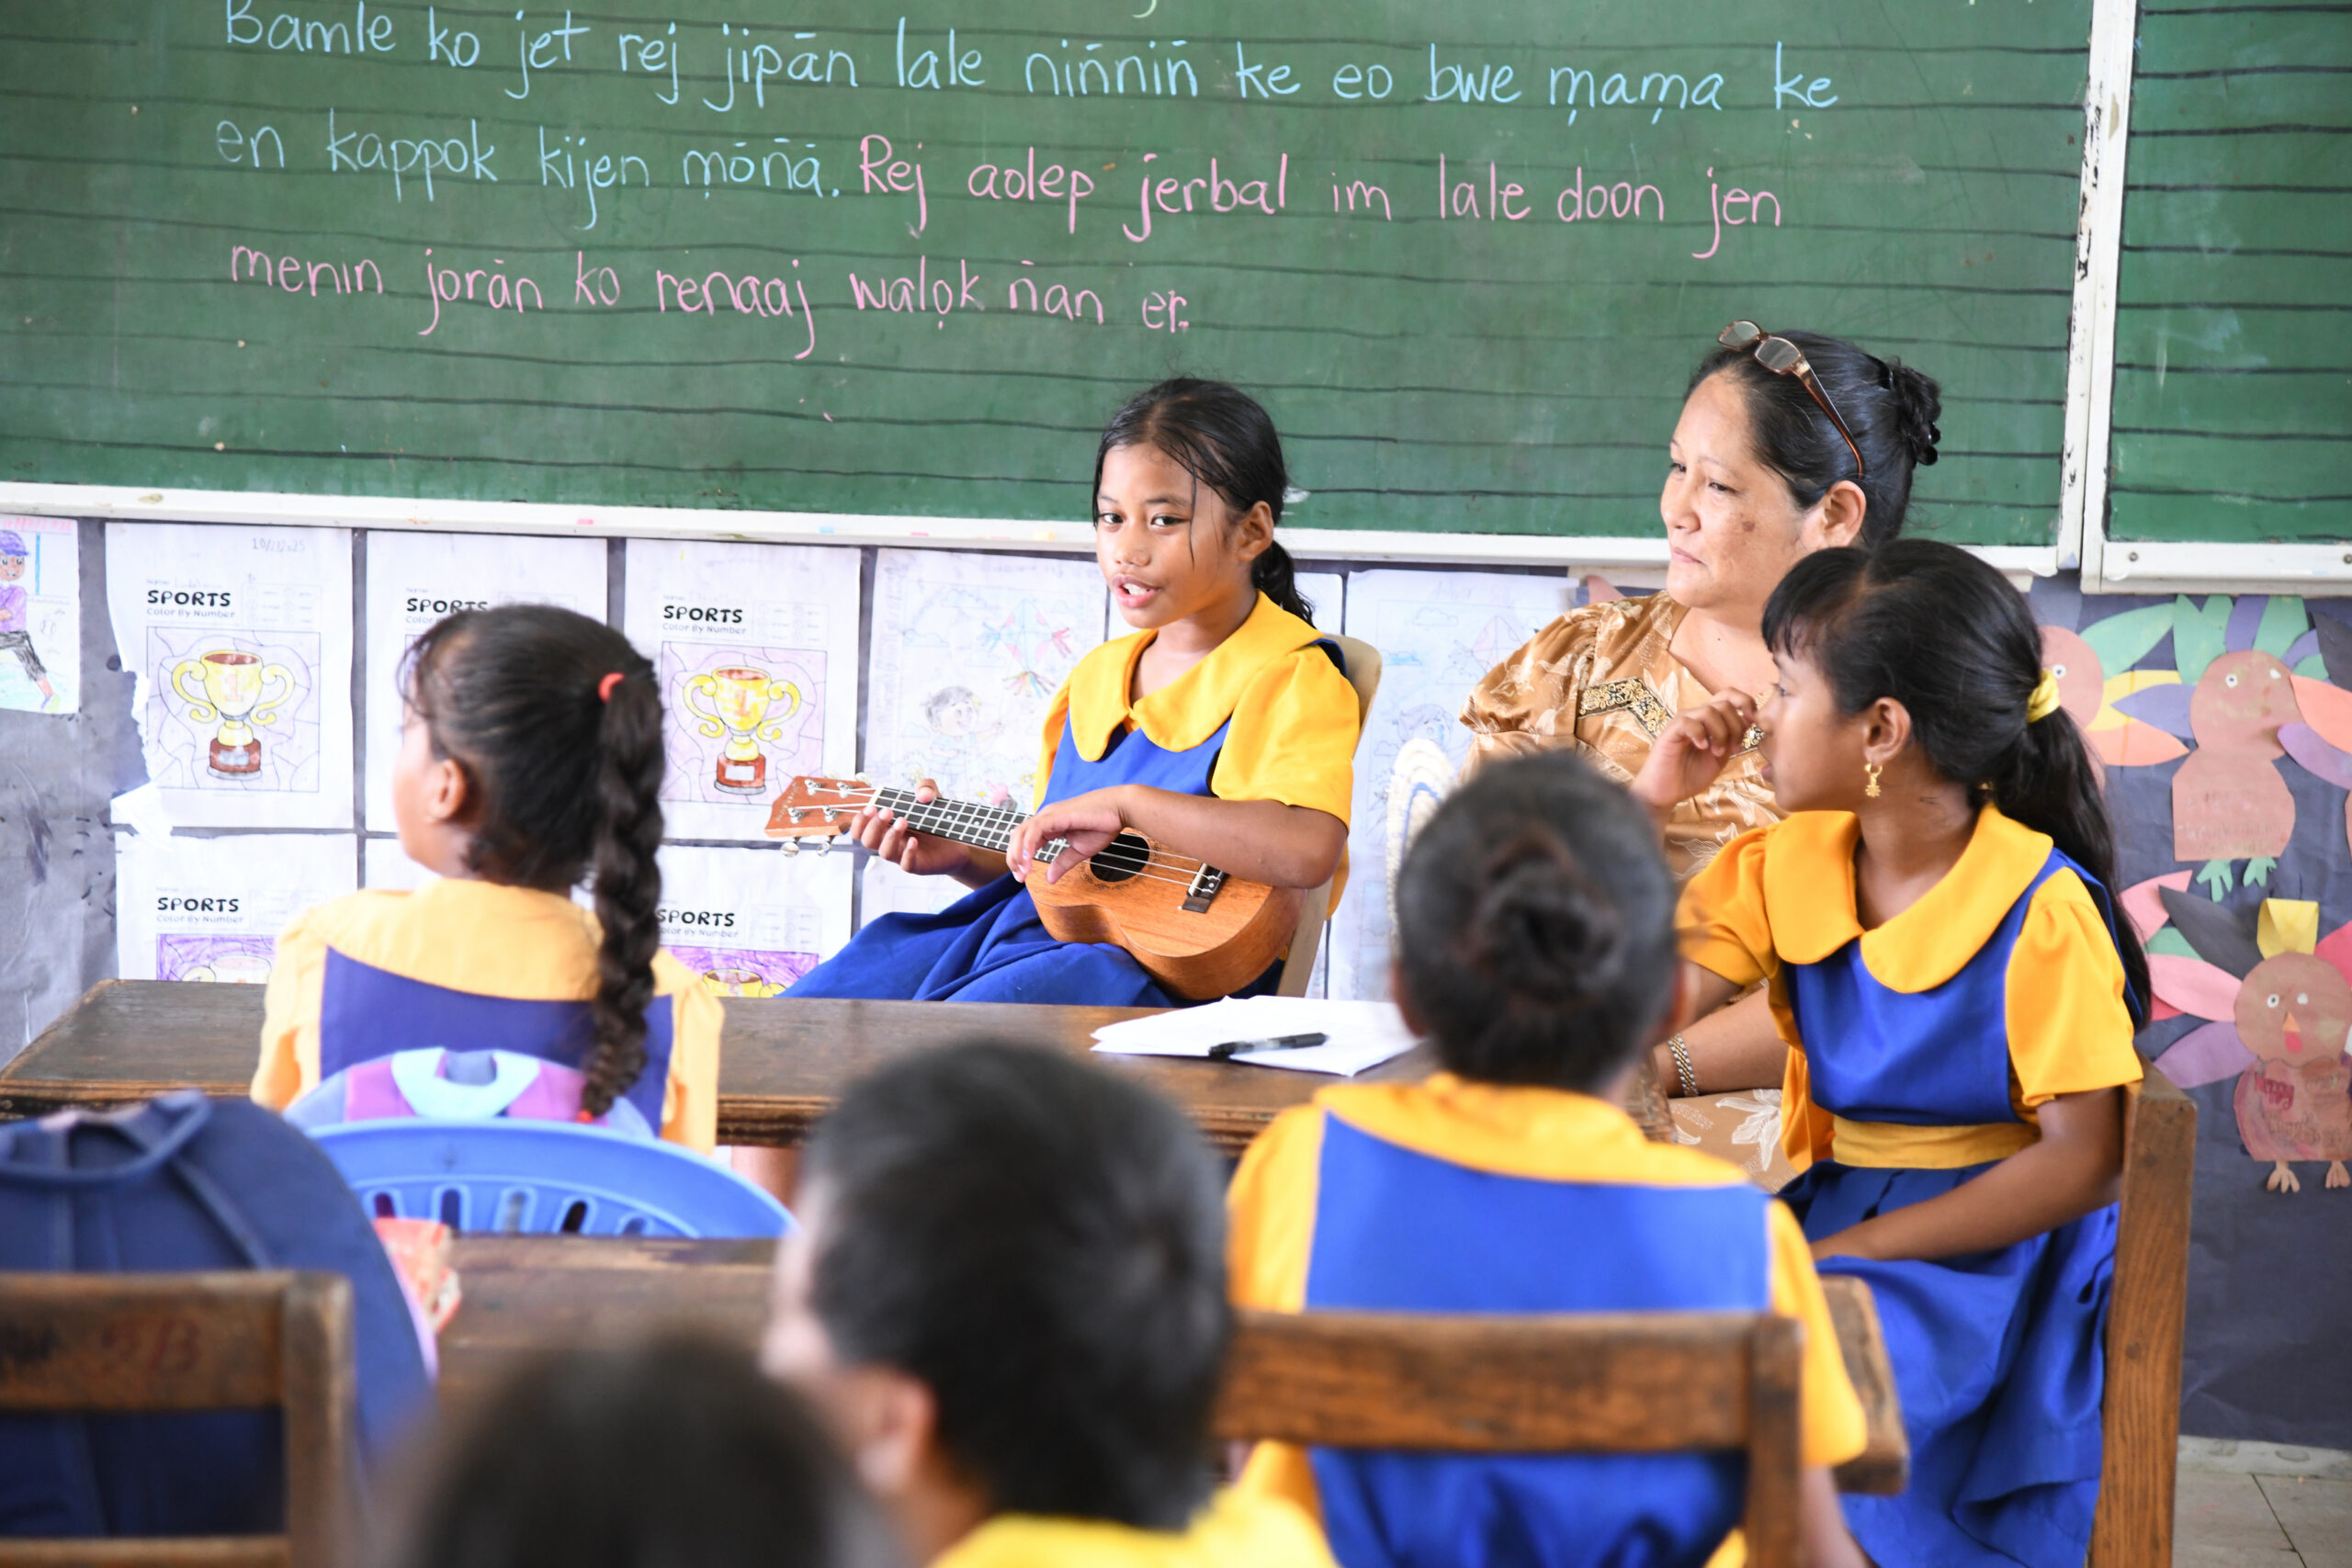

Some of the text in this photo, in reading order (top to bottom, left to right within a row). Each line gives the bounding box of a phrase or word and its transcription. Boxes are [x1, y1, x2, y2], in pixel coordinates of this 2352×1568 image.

[226, 0, 396, 54] Bamle
[429, 6, 481, 67] ko
[504, 9, 591, 100] jet
[619, 21, 680, 106] rej
[703, 23, 858, 112] jipān
[896, 16, 986, 90] lale
[1235, 40, 1301, 99] ke
[1332, 63, 1394, 99] eo
[1423, 42, 1522, 104] bwe
[1773, 40, 1838, 110] ke
[216, 119, 285, 169] en
[326, 107, 499, 202] kappok
[538, 126, 650, 231] kijen
[859, 133, 927, 233] Rej
[967, 146, 1095, 234] aolep
[1122, 152, 1288, 243] jerbal
[1332, 172, 1392, 221] im
[1439, 152, 1532, 222] lale
[1556, 165, 1665, 222] doon
[1691, 166, 1781, 260] jen
[231, 245, 383, 298] menin
[417, 248, 543, 336] jorān
[574, 250, 621, 307] ko
[656, 258, 815, 360] renaaj
[1141, 289, 1190, 333] er.
[147, 590, 232, 608] SPORTS
[406, 597, 489, 614] SPORTS
[147, 607, 236, 618] Color By Number
[662, 604, 744, 625] SPORTS
[662, 623, 747, 635] Color By Number
[156, 896, 240, 914] SPORTS
[156, 914, 243, 924] Color By Number
[655, 908, 735, 927] SPORTS
[699, 929, 739, 938] Number
